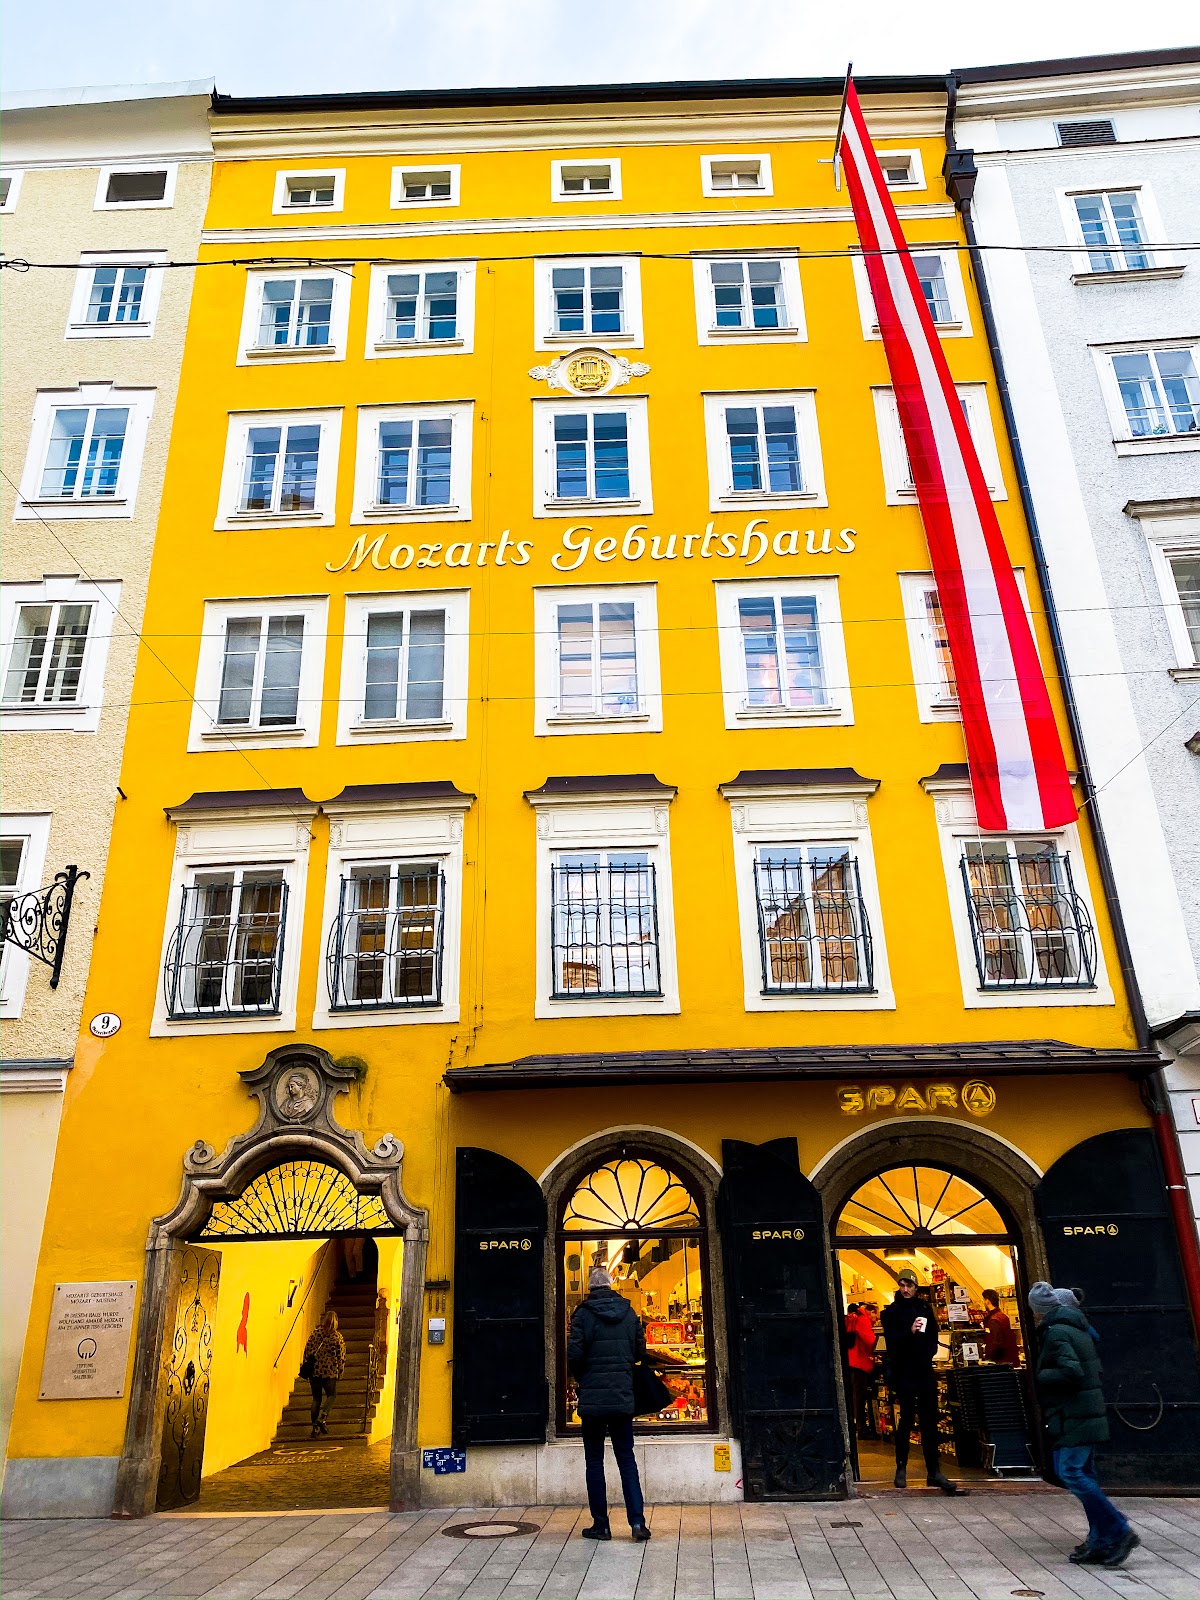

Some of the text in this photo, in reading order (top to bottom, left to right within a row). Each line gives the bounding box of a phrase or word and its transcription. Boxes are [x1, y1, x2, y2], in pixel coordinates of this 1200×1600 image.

[325, 518, 857, 573] Mozarts Geburtshaus
[101, 1015, 110, 1030] 9
[838, 1085, 958, 1114] SPAR
[752, 1230, 792, 1240] SPAR
[1063, 1226, 1106, 1236] SPAR
[479, 1240, 519, 1250] SPAR
